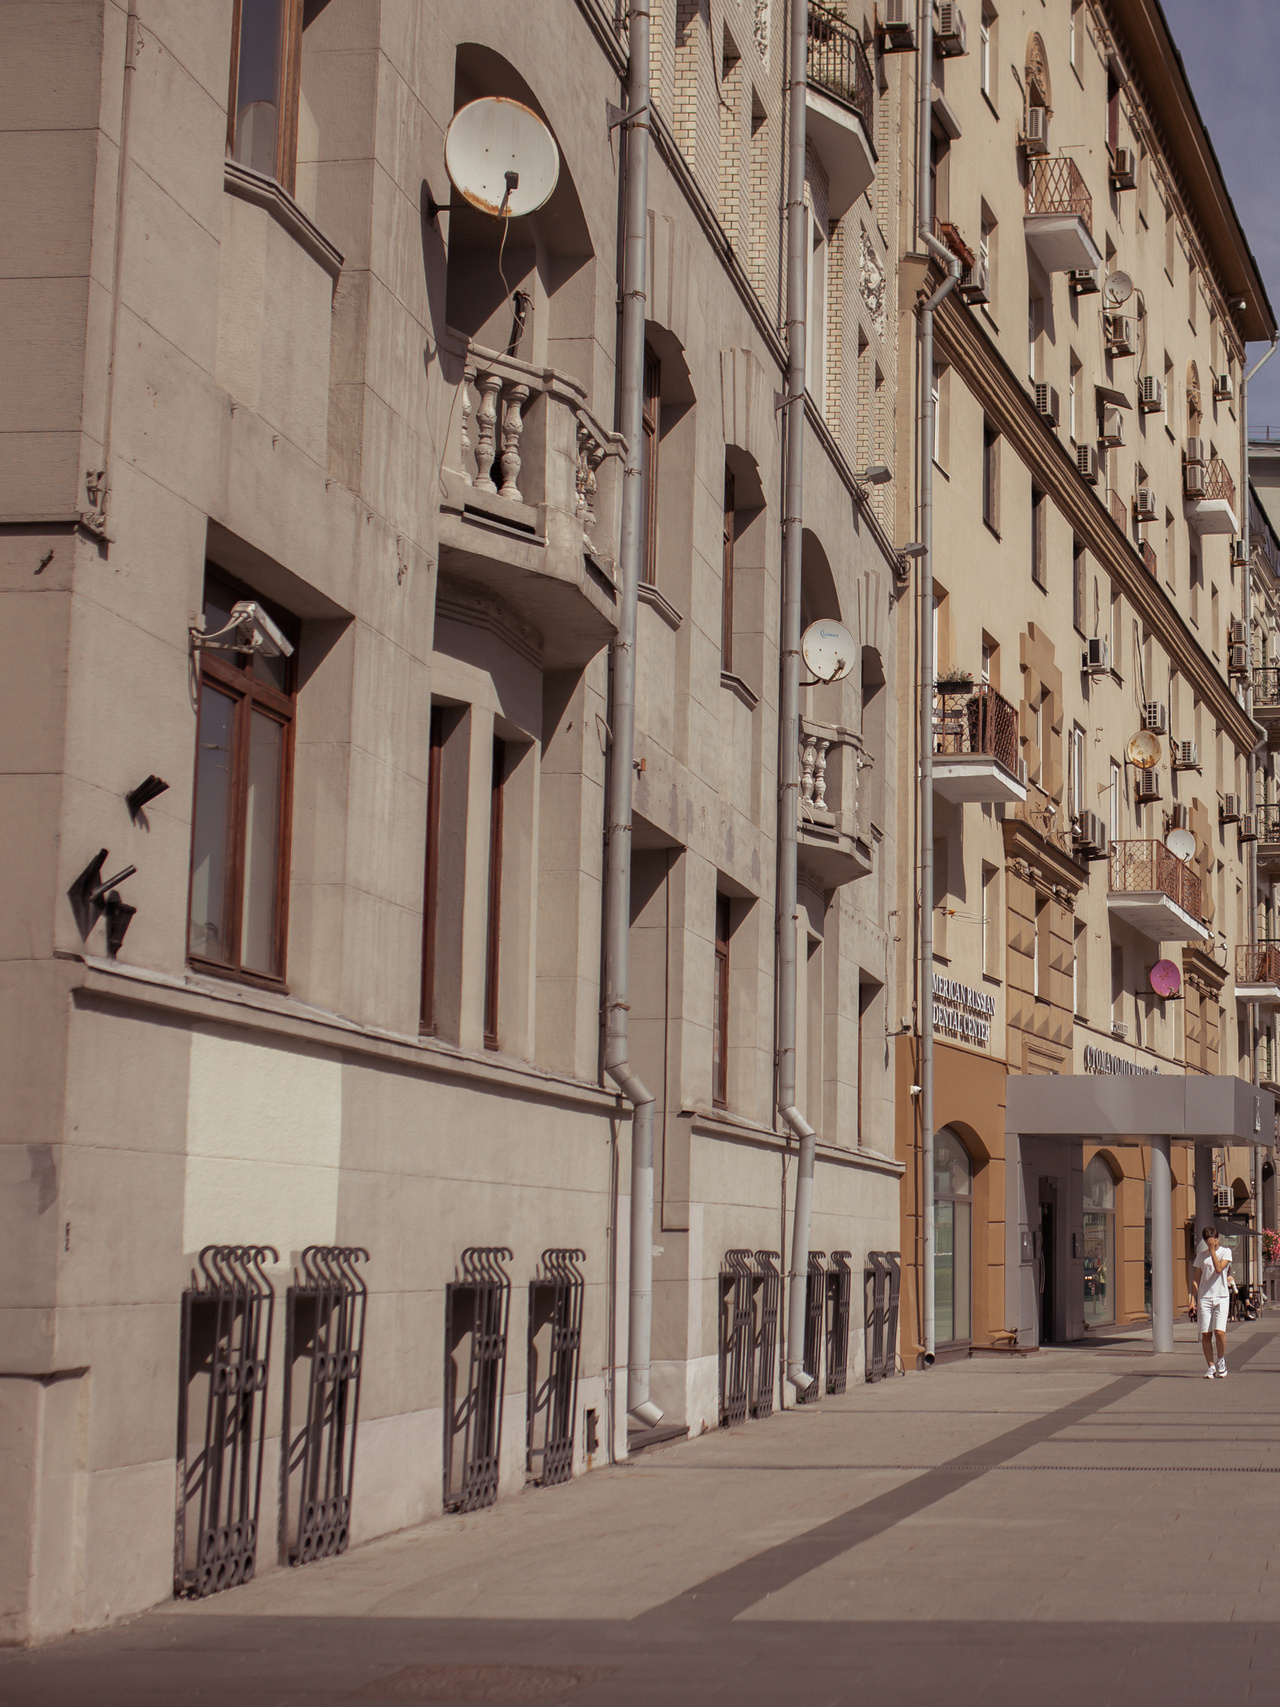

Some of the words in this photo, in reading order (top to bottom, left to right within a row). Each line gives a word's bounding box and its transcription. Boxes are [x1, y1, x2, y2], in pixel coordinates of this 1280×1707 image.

[932, 973, 966, 1005] MERICAN
[967, 986, 995, 1016] RUSSIAN
[933, 1004, 963, 1031] DENTAL
[963, 1014, 990, 1042] CENTER
